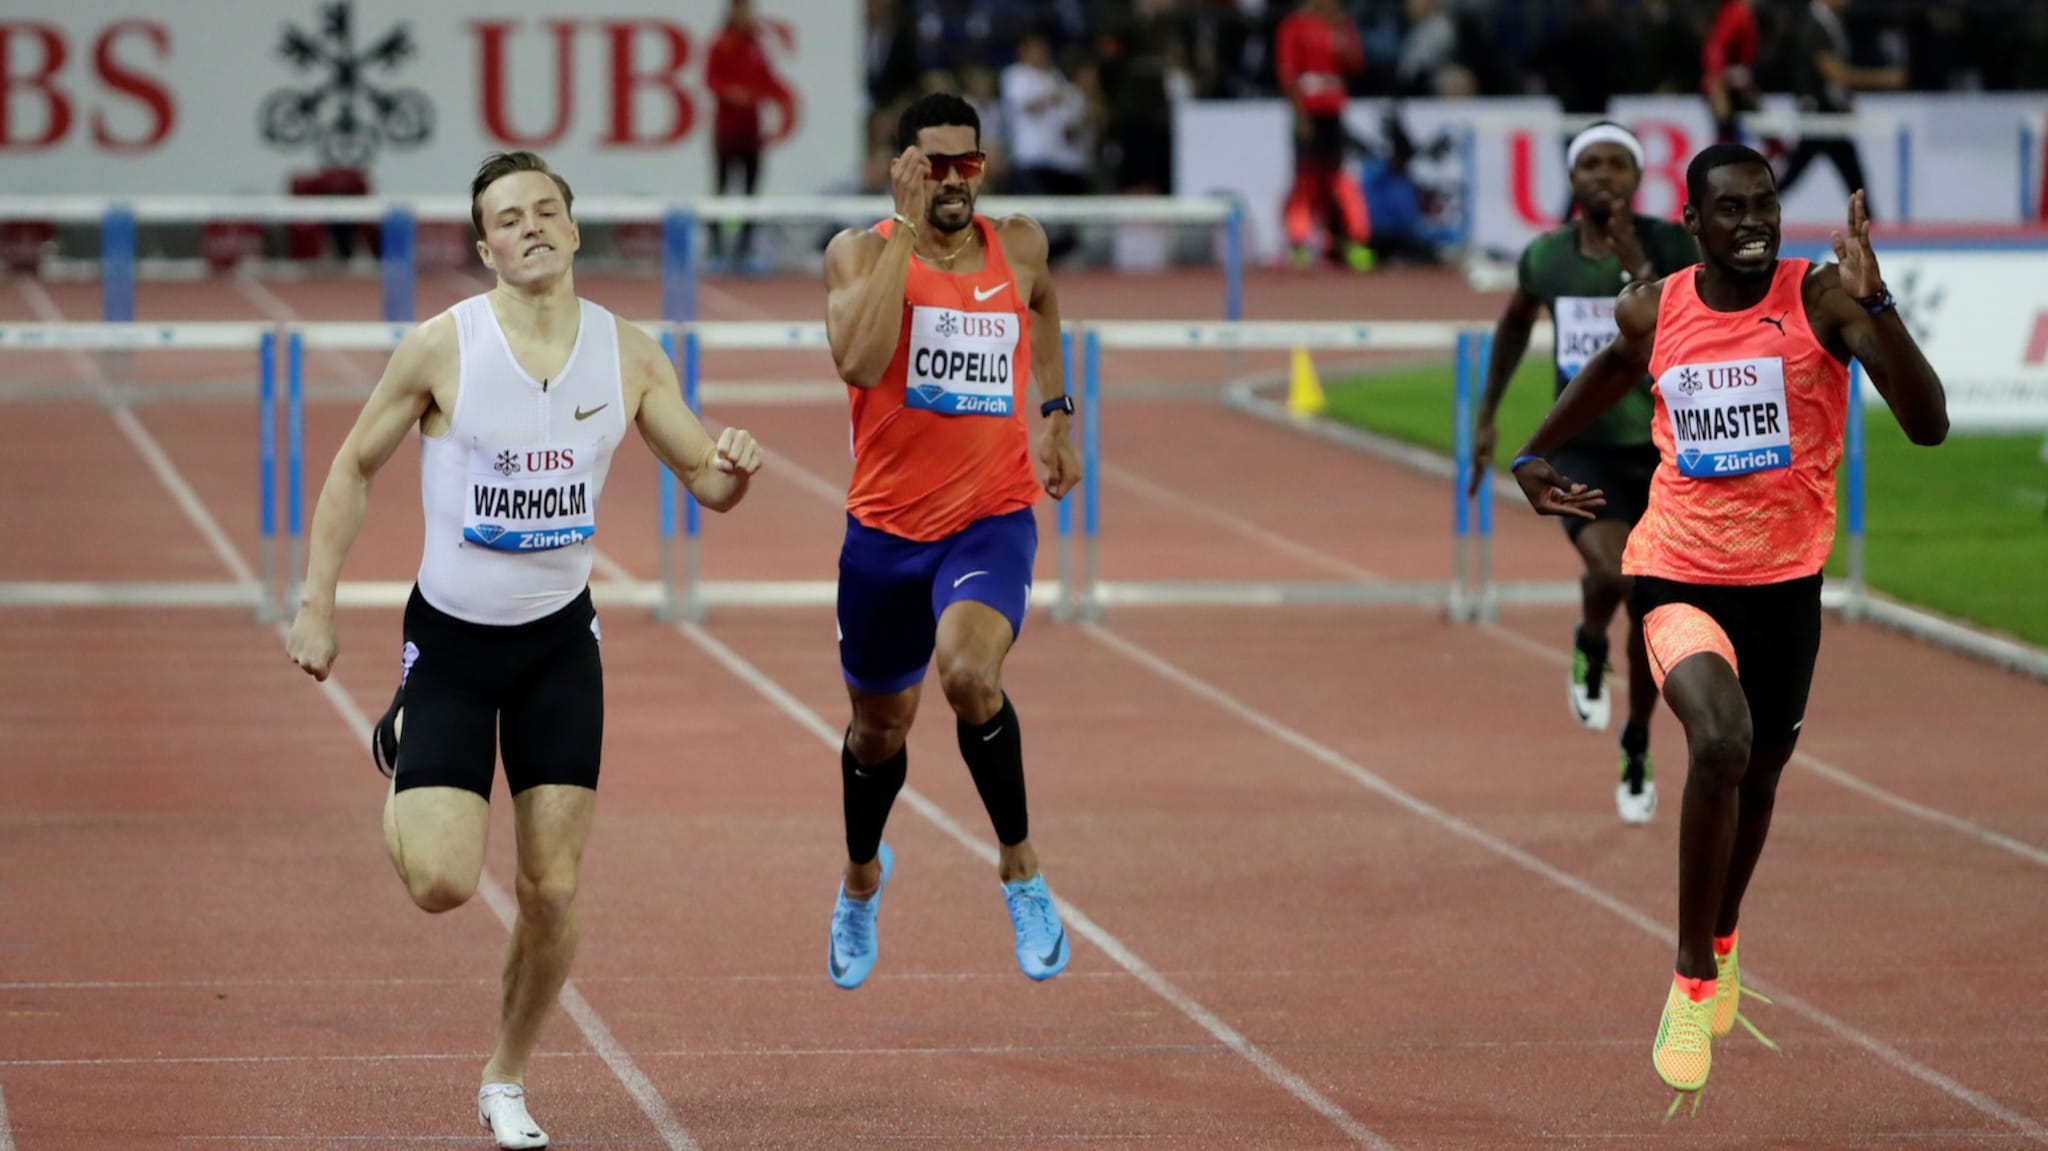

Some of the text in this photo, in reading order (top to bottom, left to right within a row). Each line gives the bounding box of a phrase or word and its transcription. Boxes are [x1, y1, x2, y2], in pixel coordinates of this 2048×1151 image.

[963, 317, 1005, 338] UBS
[915, 347, 1008, 384] COPELLO
[1707, 365, 1758, 390] UBS
[955, 395, 1008, 413] Zürich
[1674, 402, 1781, 441] MCMASTER
[526, 449, 574, 473] UBS
[1713, 450, 1780, 473] Zürich
[474, 482, 587, 520] WARHOLM
[519, 530, 584, 549] Zürich
